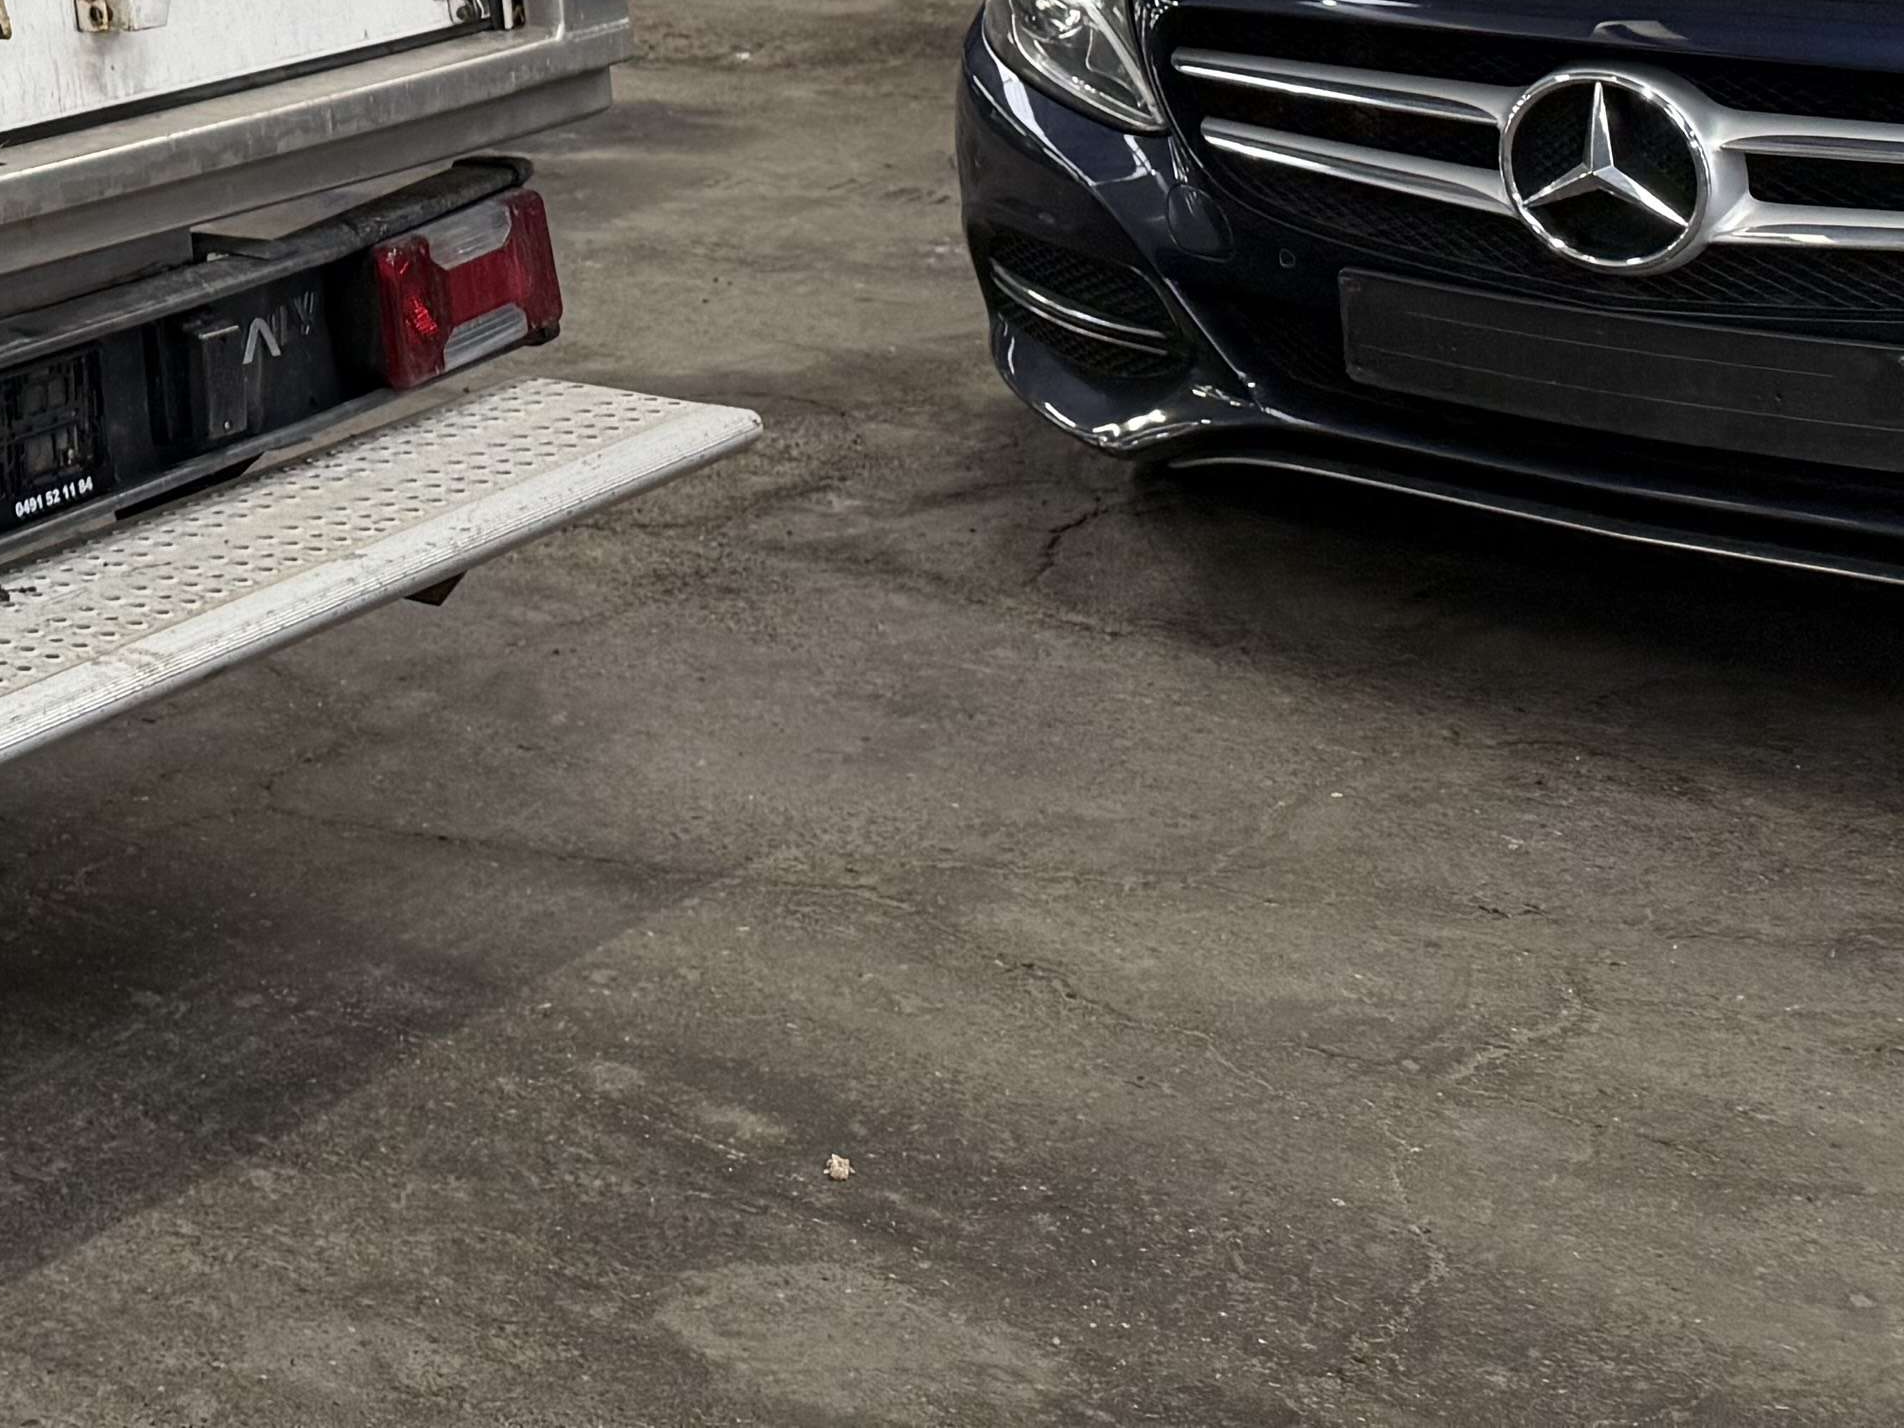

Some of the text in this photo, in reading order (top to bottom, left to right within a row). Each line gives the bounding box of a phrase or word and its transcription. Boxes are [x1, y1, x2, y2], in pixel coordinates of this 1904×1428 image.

[15, 476, 93, 517] 0491 52 11 84
